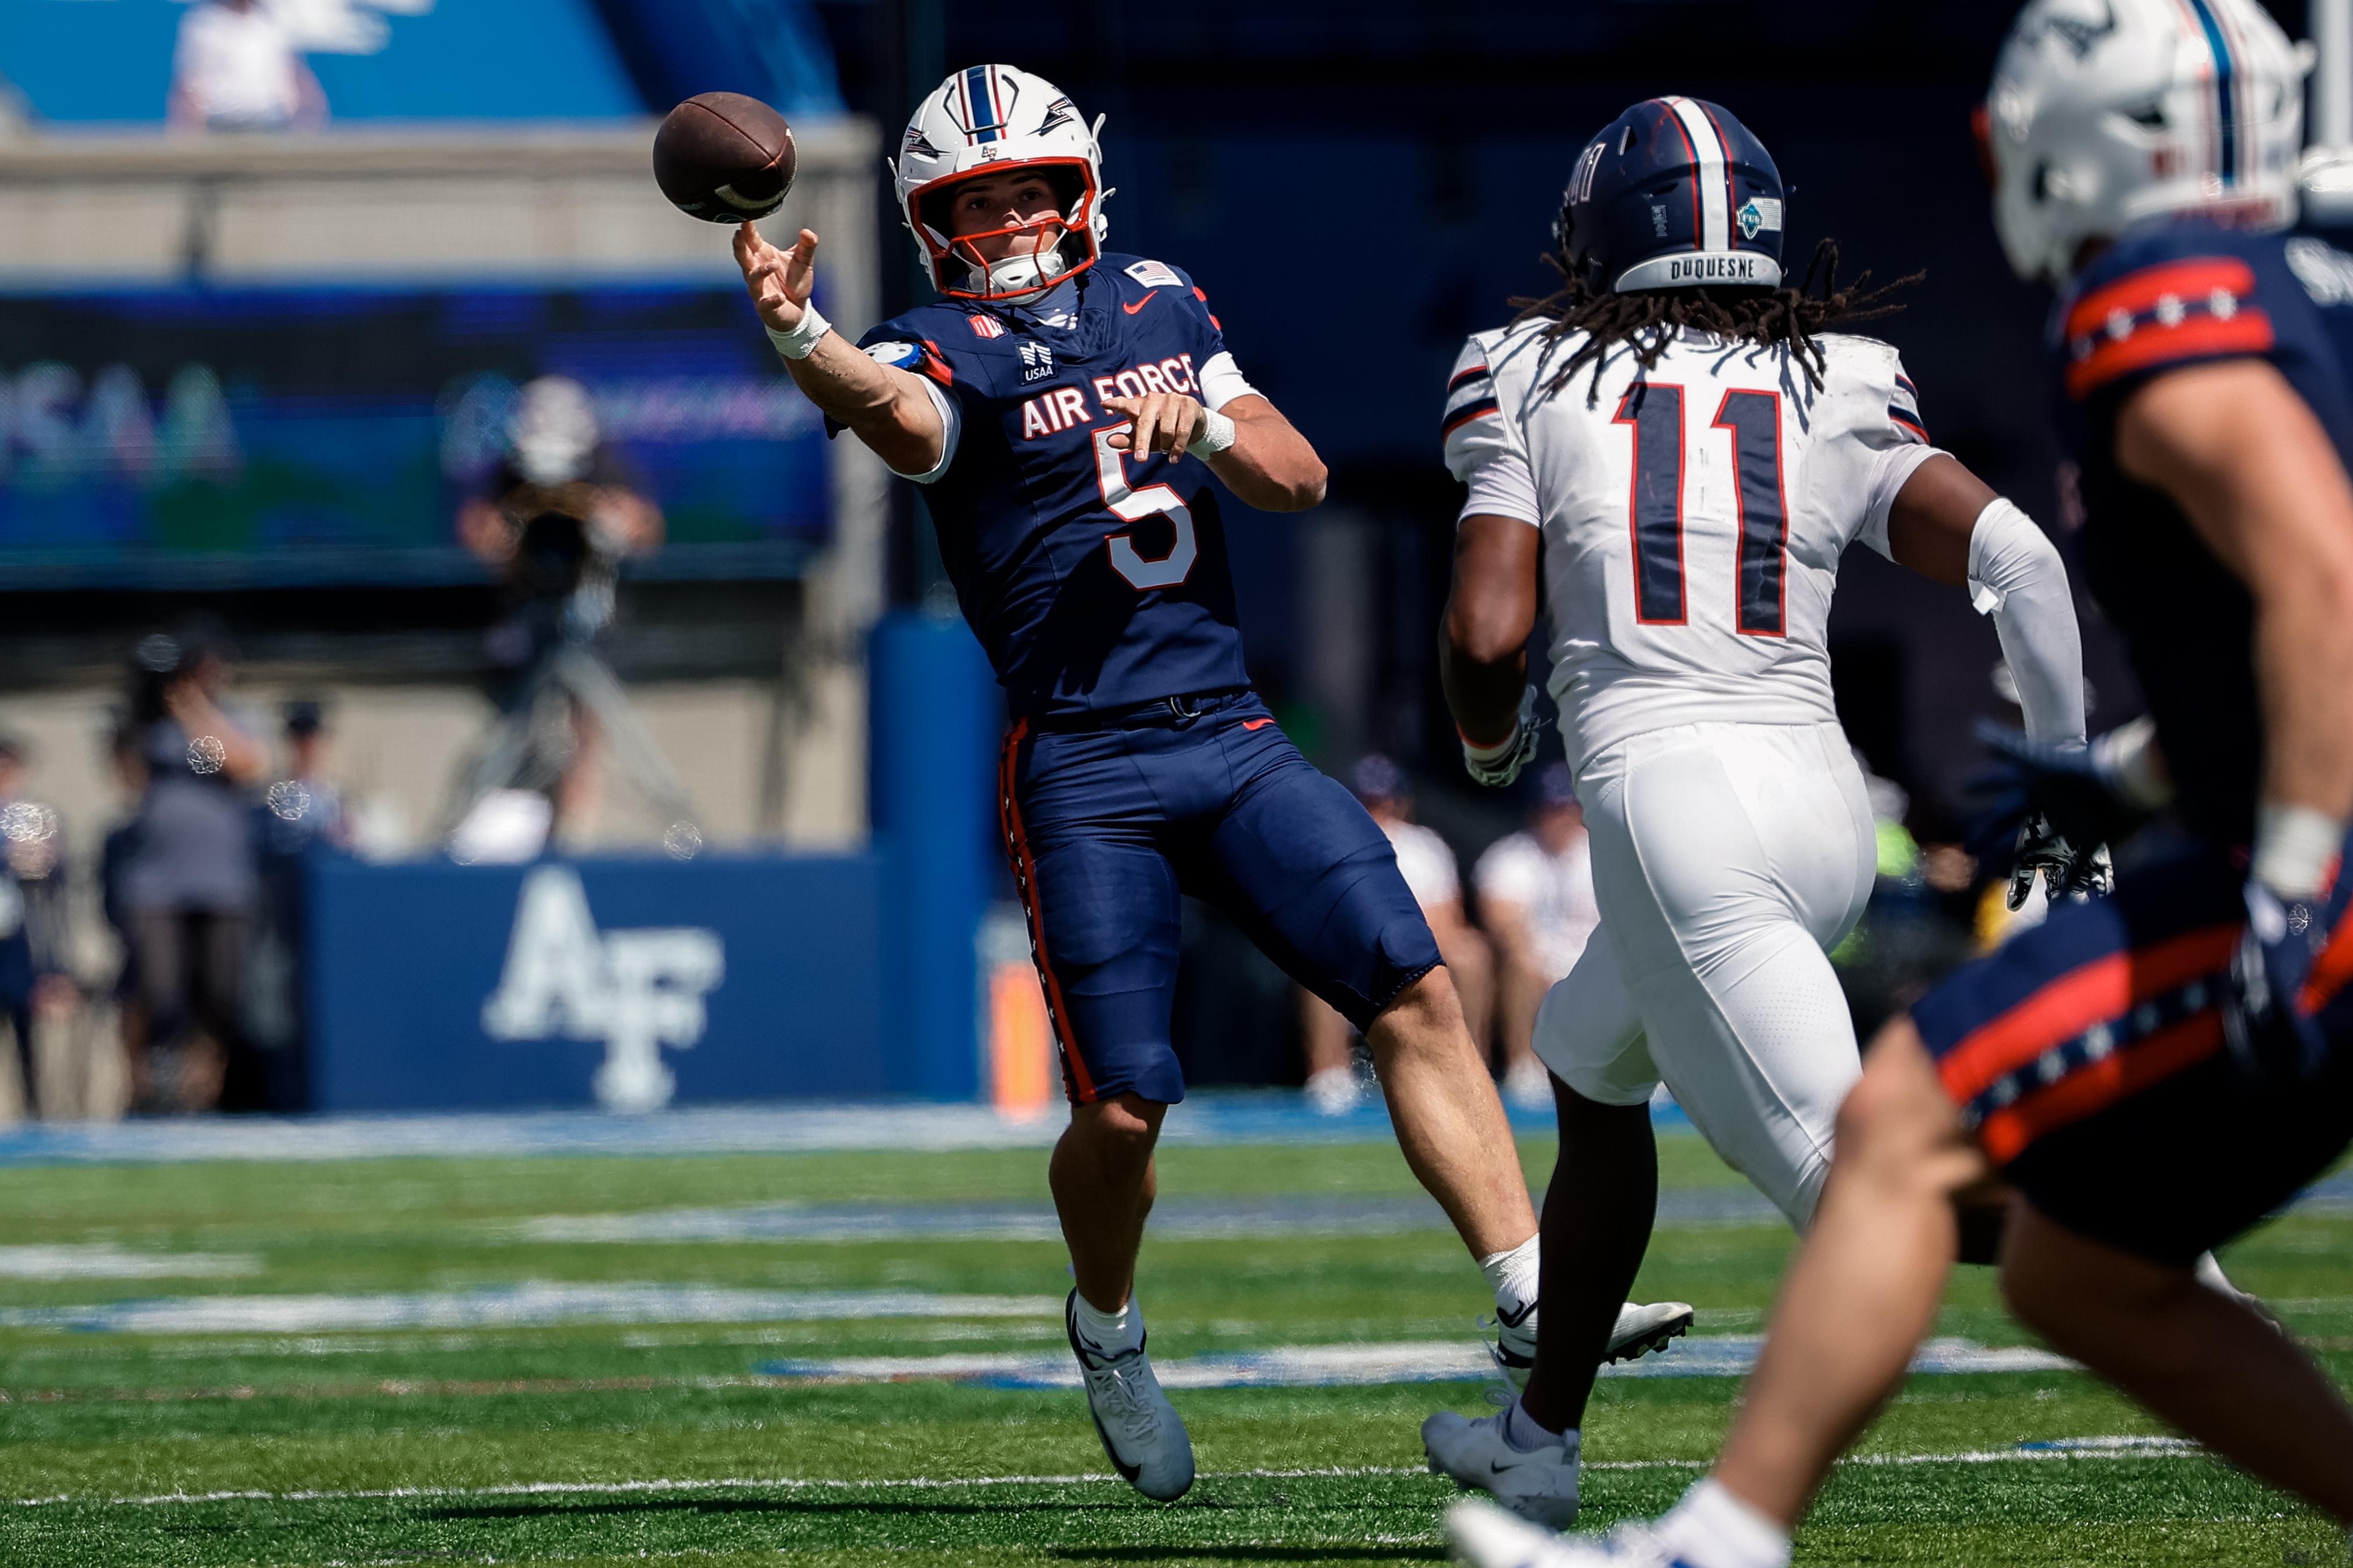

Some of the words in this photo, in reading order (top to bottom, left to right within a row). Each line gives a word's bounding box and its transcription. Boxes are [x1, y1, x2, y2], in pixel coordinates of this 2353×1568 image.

[1671, 258, 1753, 280] DUQUESNE
[0, 357, 248, 493] SAA
[1023, 387, 1093, 441] AIR
[1025, 365, 1053, 381] USAA
[1091, 419, 1199, 592] 5
[1611, 381, 1788, 637] 11
[481, 864, 726, 1114] AF
